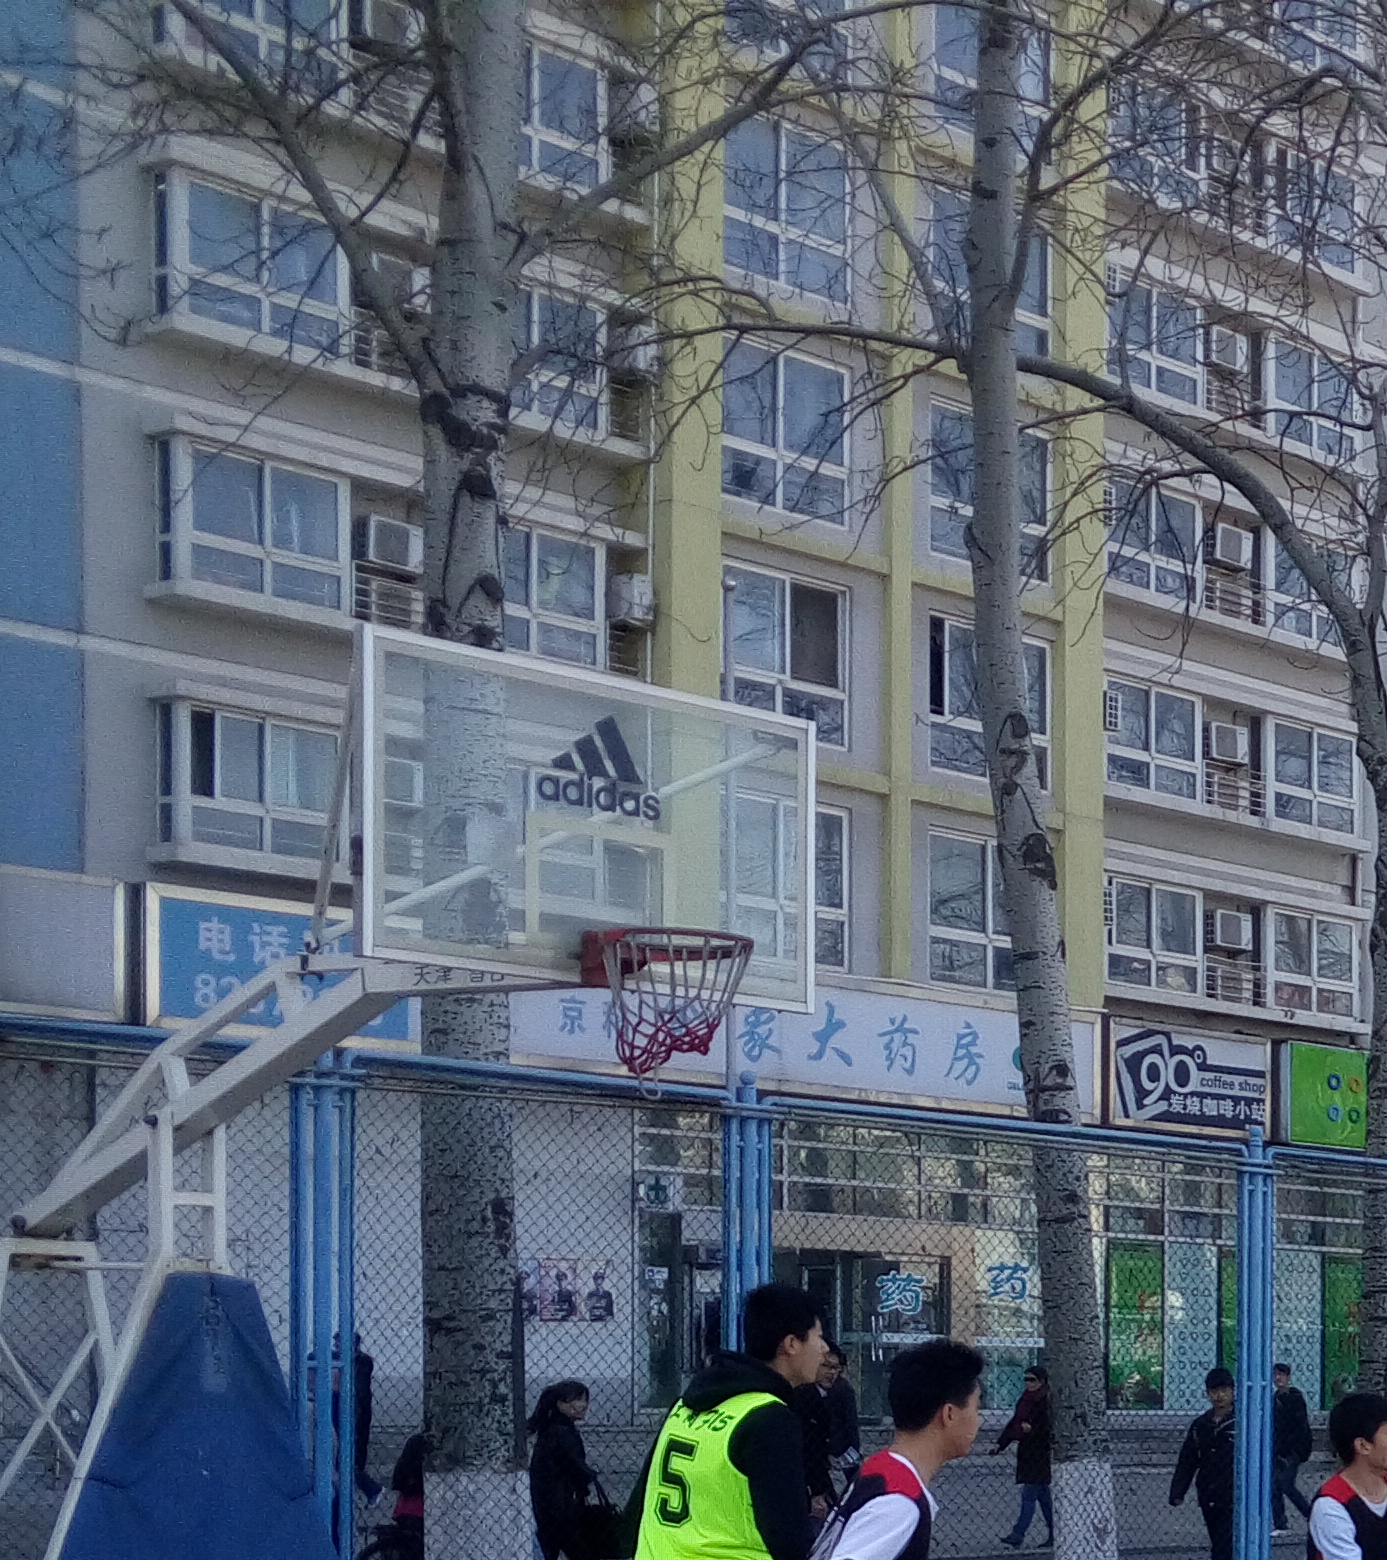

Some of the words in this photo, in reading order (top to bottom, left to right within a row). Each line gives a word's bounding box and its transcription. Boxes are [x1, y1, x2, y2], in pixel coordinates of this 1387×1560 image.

[537, 768, 661, 820] adidas
[1168, 1093, 1266, 1122] 炭烧咖啡小站
[1200, 1076, 1235, 1091] coffee
[1238, 1080, 1266, 1098] shop
[876, 1270, 926, 1315] 药
[987, 1262, 1030, 1300] 药
[654, 1433, 700, 1528] 5
